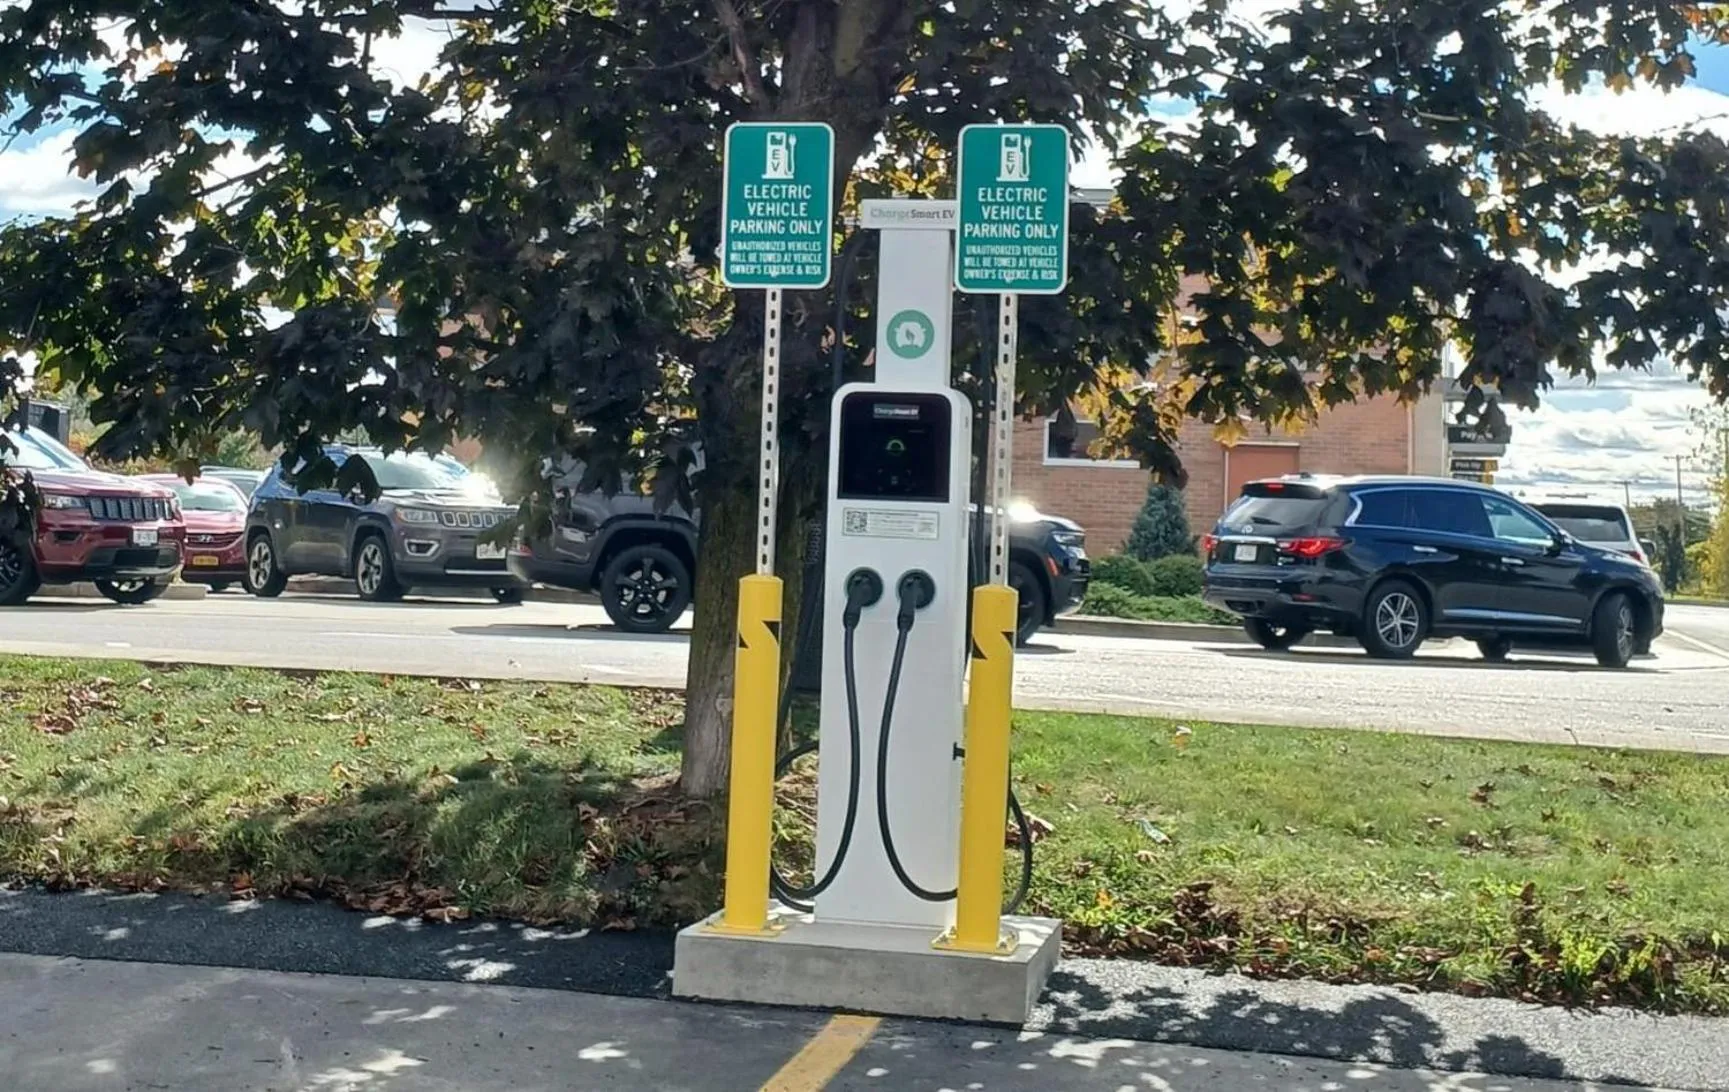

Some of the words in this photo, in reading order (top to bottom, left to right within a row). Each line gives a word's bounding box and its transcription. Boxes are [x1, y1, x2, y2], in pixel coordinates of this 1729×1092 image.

[743, 184, 812, 199] ELECTRIC
[978, 187, 1047, 202] ELECTRIC
[747, 202, 808, 217] VEHICLE
[942, 210, 955, 219] EV
[981, 205, 1043, 220] VEHICLE
[730, 219, 786, 234] PARKING
[789, 220, 823, 234] ONLY
[964, 223, 1020, 238] PARKING
[1025, 224, 1059, 239] ONLY
[732, 241, 786, 251] UNAUTHORIZED
[788, 241, 821, 251] VEHICLES
[966, 245, 1020, 255] UNAUTHORIZED
[1023, 245, 1057, 256] VEHICLES
[730, 252, 746, 262] WILL
[748, 252, 757, 262] BE
[759, 252, 782, 262] TOWED
[783, 253, 791, 262] AT
[793, 253, 822, 263] VEHICLE
[964, 257, 980, 267] WILL
[982, 257, 992, 267] BE
[994, 257, 1016, 267] TOWED
[1018, 257, 1027, 268] AT
[1029, 257, 1058, 268] VEHICLE
[730, 264, 761, 274] OWNER'S
[805, 264, 821, 275] RISK
[964, 269, 996, 279] OWNER'S
[1041, 270, 1058, 280] RISK
